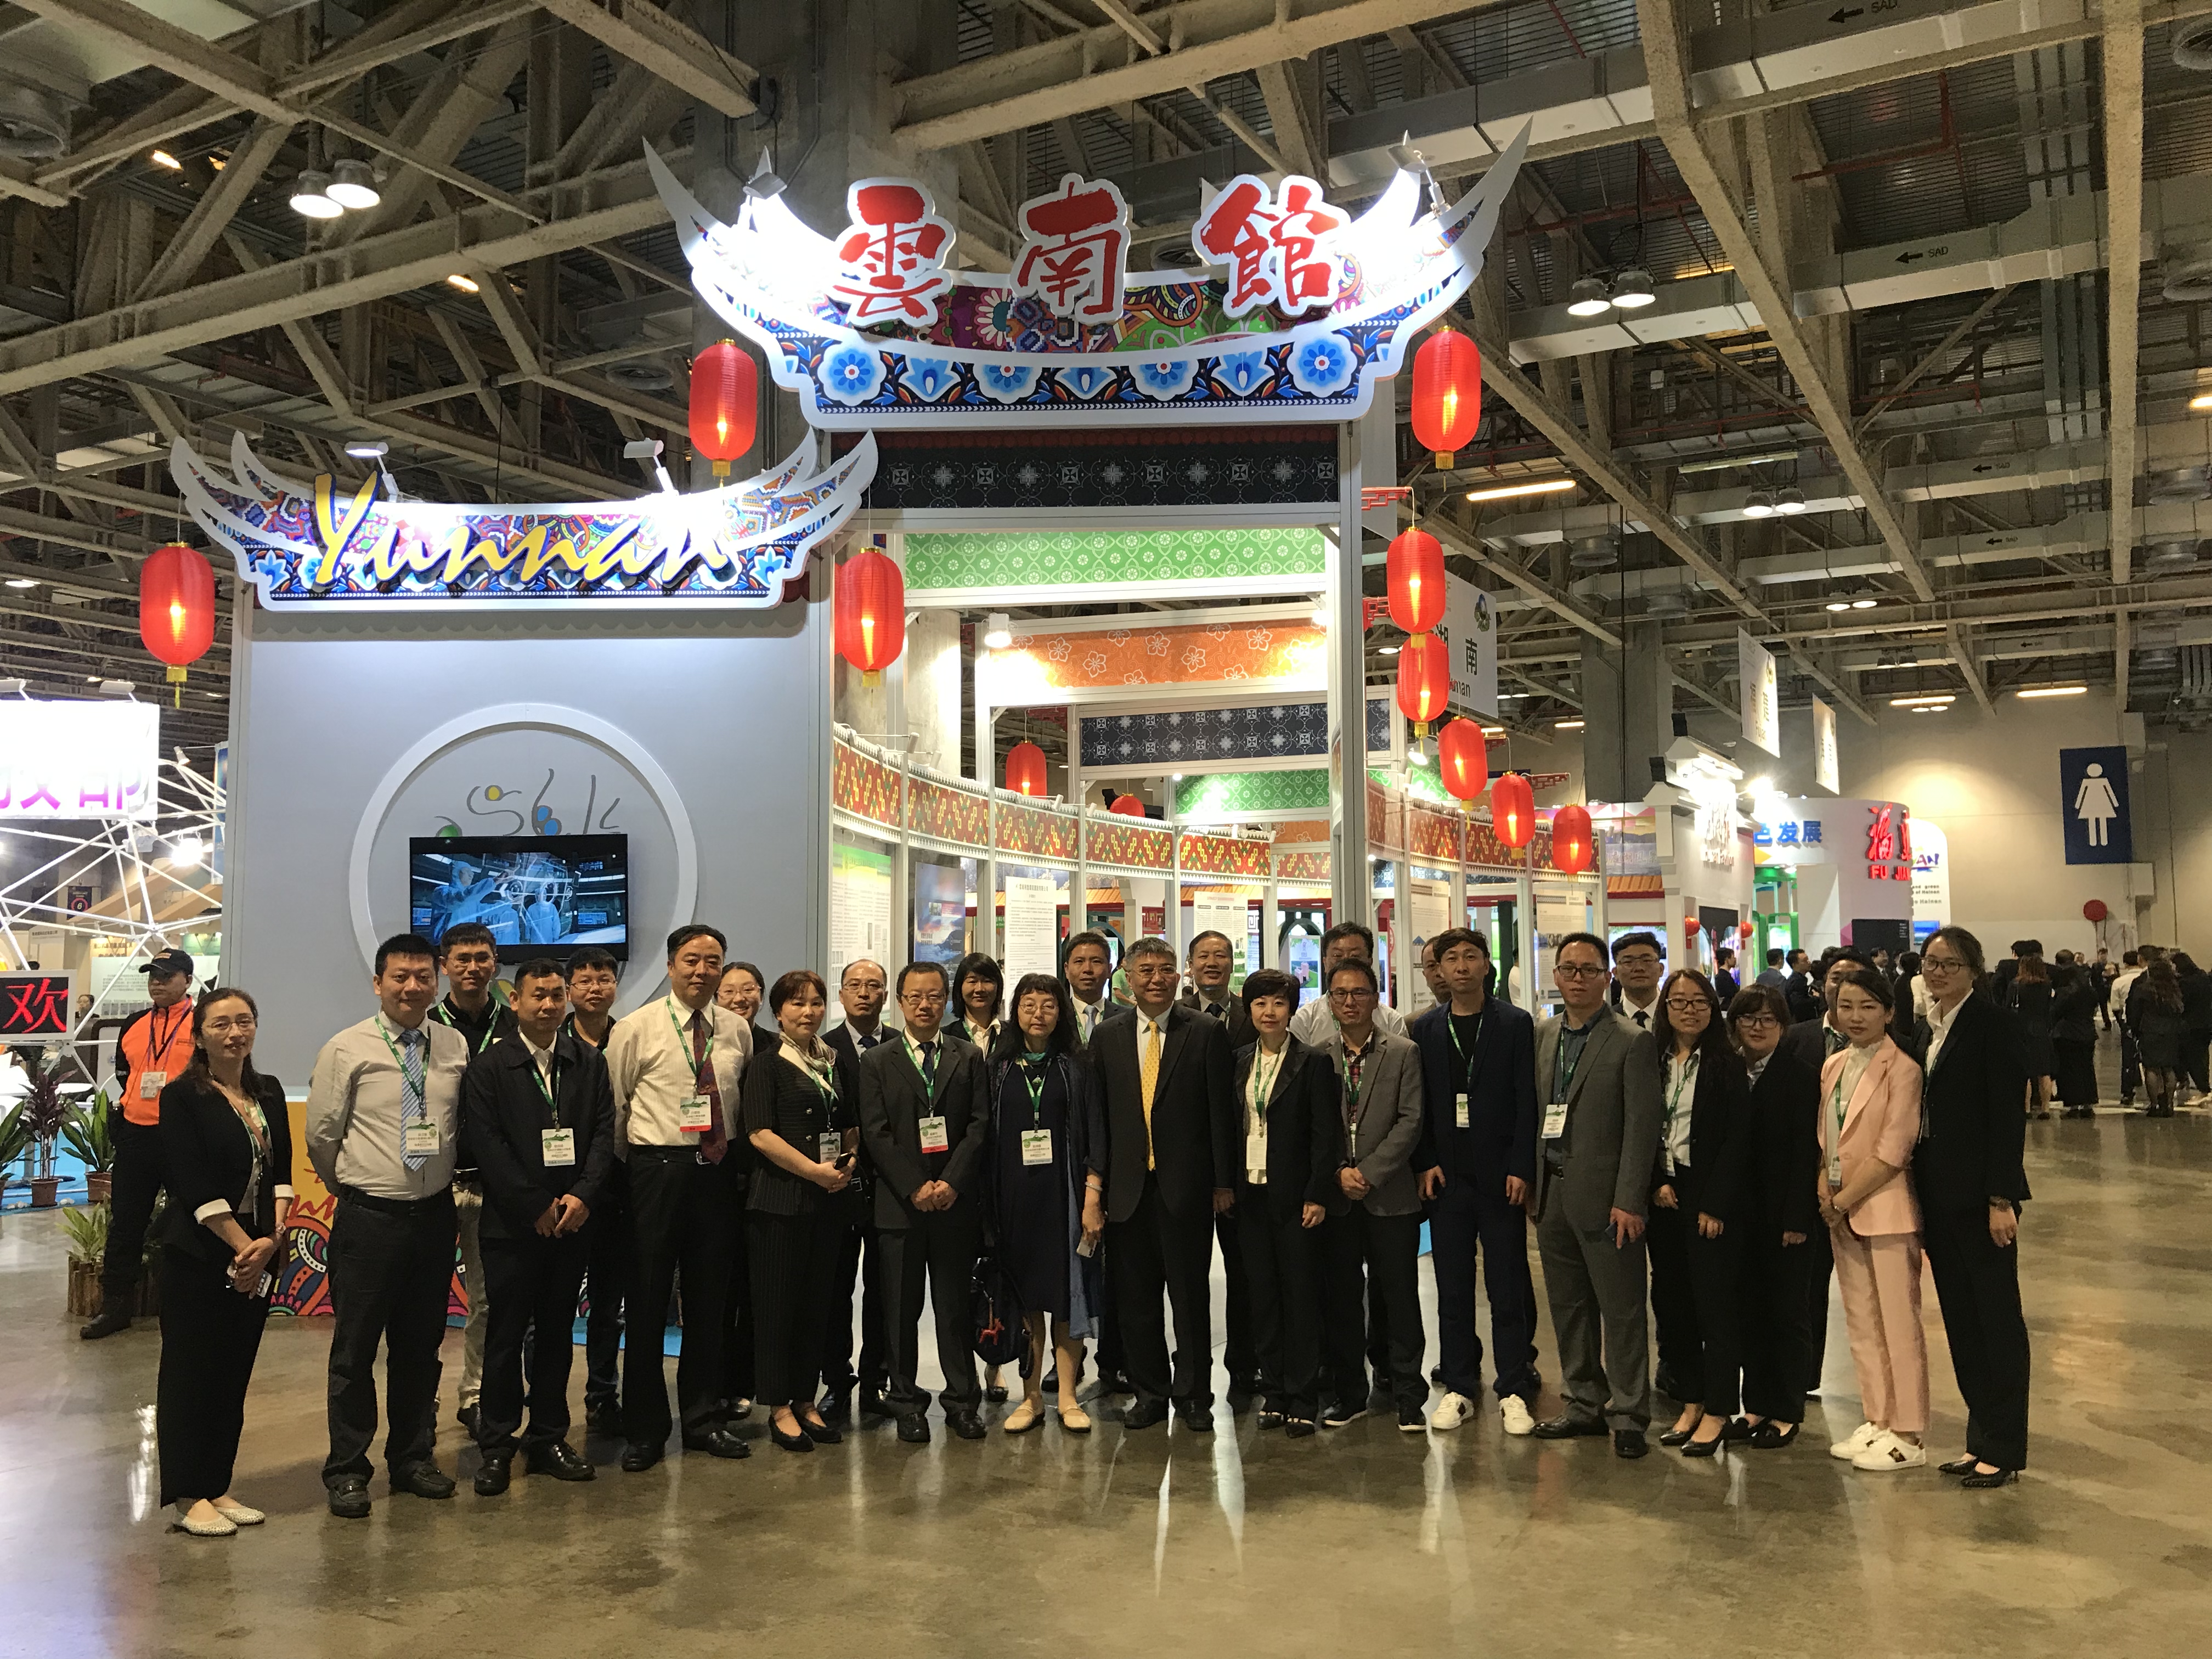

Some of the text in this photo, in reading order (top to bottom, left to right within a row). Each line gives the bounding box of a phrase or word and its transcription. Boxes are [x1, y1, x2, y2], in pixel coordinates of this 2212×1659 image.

[831, 178, 1340, 319] 雲南館
[1927, 246, 1949, 258] SAD
[312, 470, 730, 586] Yunnan
[1870, 865, 1889, 881] FU
[2, 978, 69, 1034] 欢
